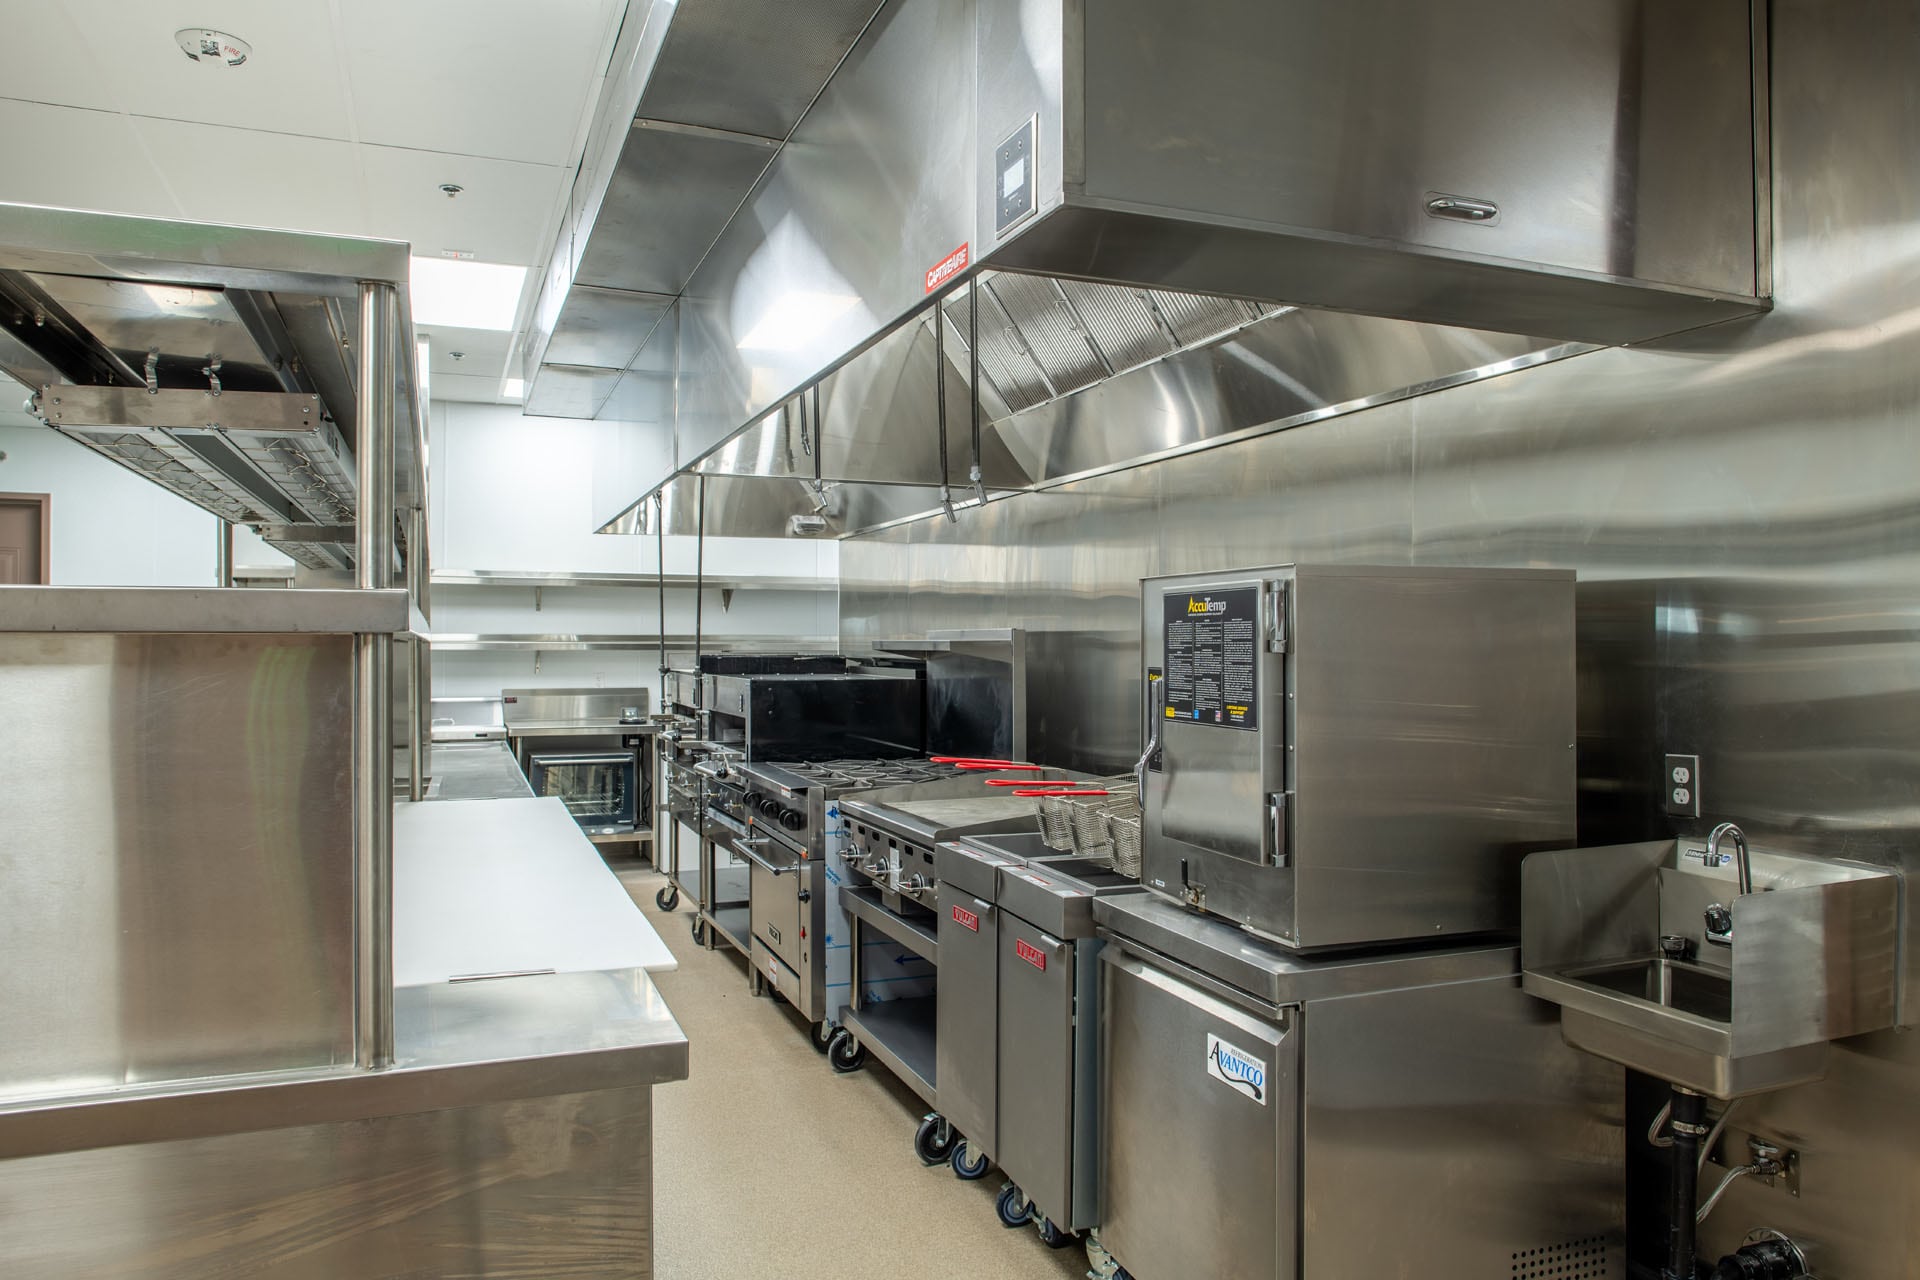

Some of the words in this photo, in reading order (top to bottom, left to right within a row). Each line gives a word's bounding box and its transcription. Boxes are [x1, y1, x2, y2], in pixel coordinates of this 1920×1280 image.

[224, 45, 240, 57] FIRE
[1187, 596, 1226, 615] AccuTemp
[954, 908, 975, 927] VULCAN
[1018, 941, 1043, 967] VULCAN
[1209, 1042, 1263, 1088] AVANTCO
